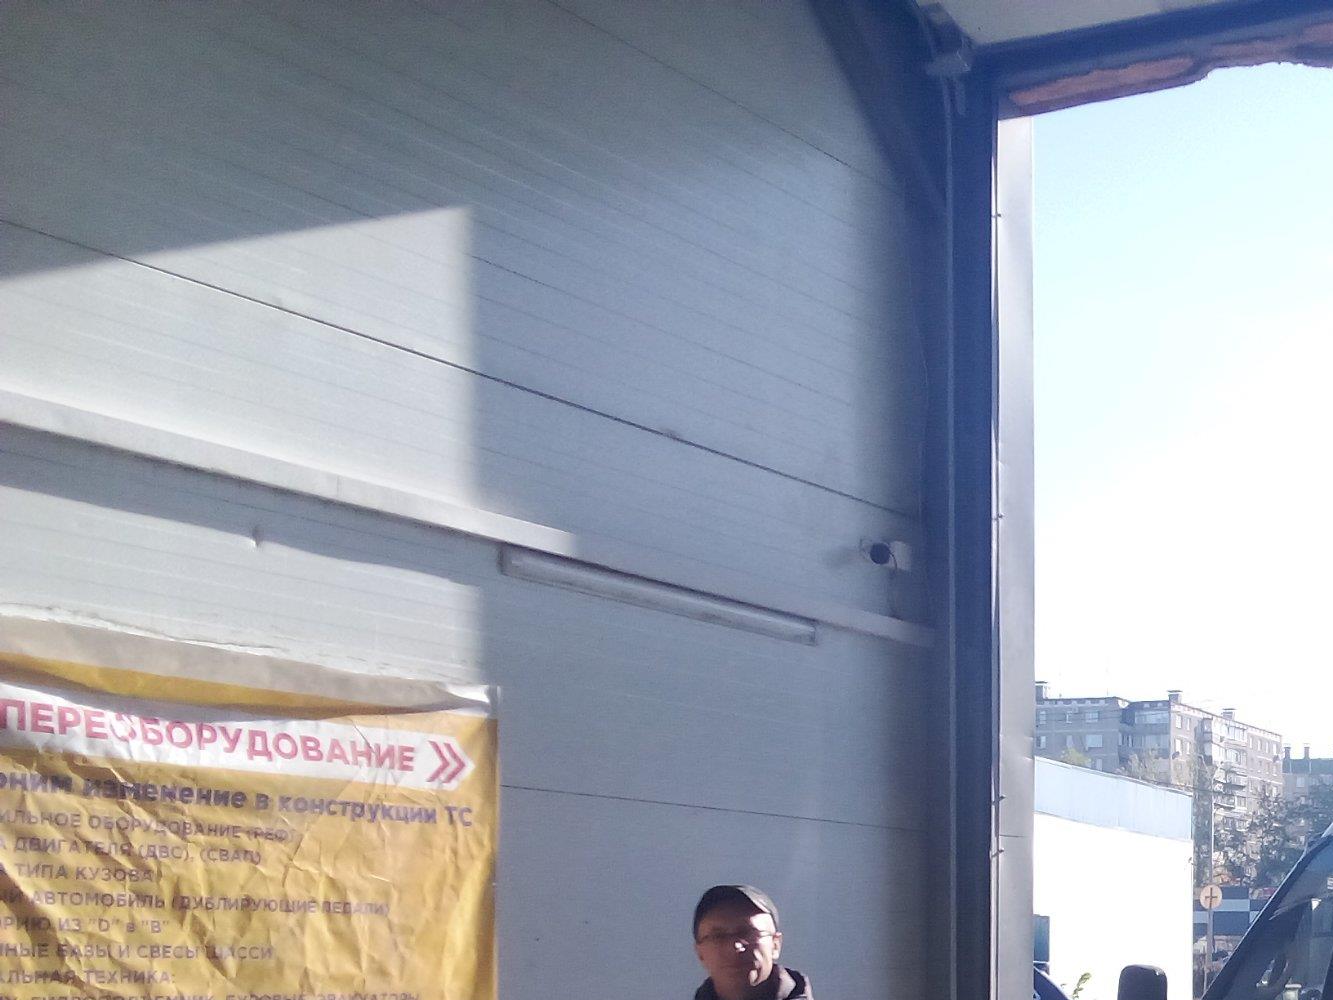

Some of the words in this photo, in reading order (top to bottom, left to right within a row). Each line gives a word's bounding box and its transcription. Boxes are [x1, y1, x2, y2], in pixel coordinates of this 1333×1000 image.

[0, 700, 414, 771] ПЕРЕОБОРУДОВАНИЕ
[278, 795, 436, 824] конструкции
[444, 806, 473, 826] ТС
[16, 863, 68, 880] ТИПА
[75, 867, 156, 882] КУЗОВА
[33, 892, 165, 909] АВТОМОБИЛЬ
[0, 943, 48, 957] НЫЕ
[137, 946, 197, 960] СВЕСЫ
